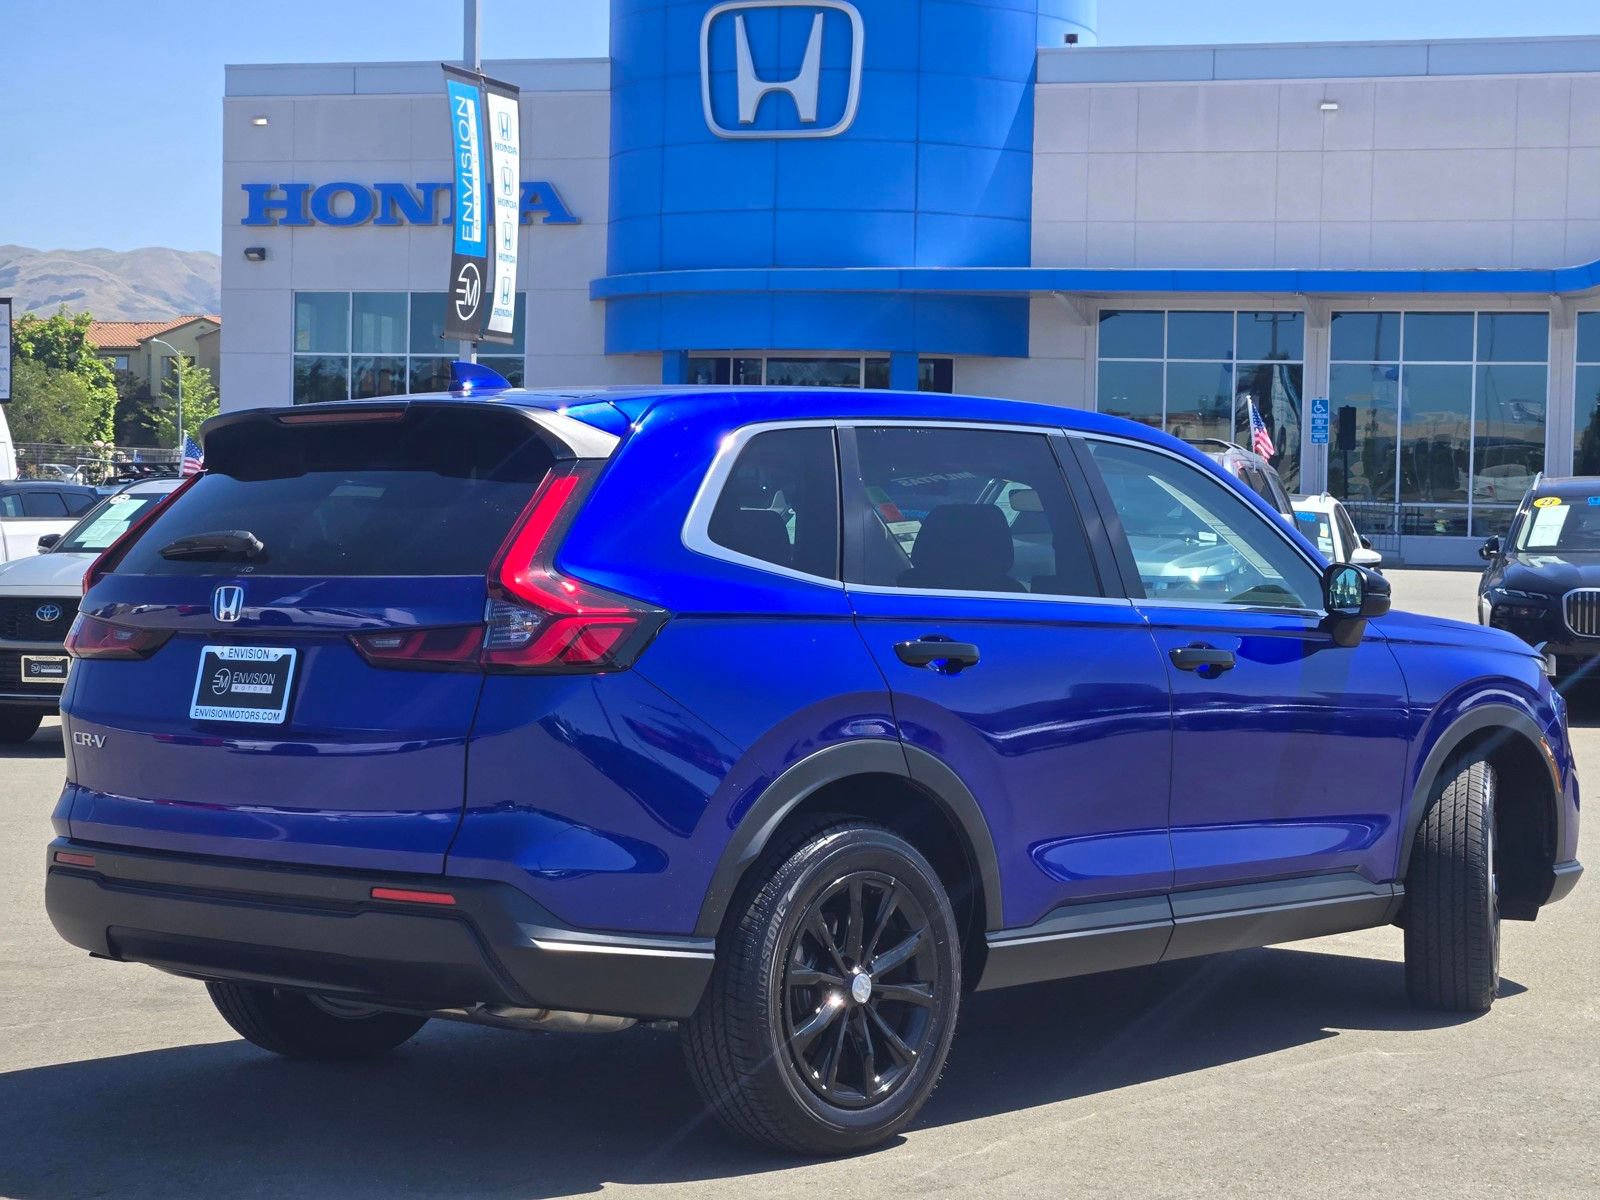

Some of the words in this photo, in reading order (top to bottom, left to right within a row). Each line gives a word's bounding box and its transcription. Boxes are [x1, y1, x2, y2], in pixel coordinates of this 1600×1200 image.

[494, 141, 518, 155] HONDA
[455, 95, 475, 241] ENVISION
[240, 181, 581, 226] HONA
[497, 197, 518, 210] HONDA
[498, 253, 516, 264] HONDA
[494, 307, 512, 318] HONDA
[227, 648, 270, 660] ENVISION
[232, 671, 276, 685] ENVISION
[234, 685, 271, 693] MOTORS
[194, 708, 280, 721] ENVISIONMOTORS.COM
[74, 731, 107, 748] CR-V
